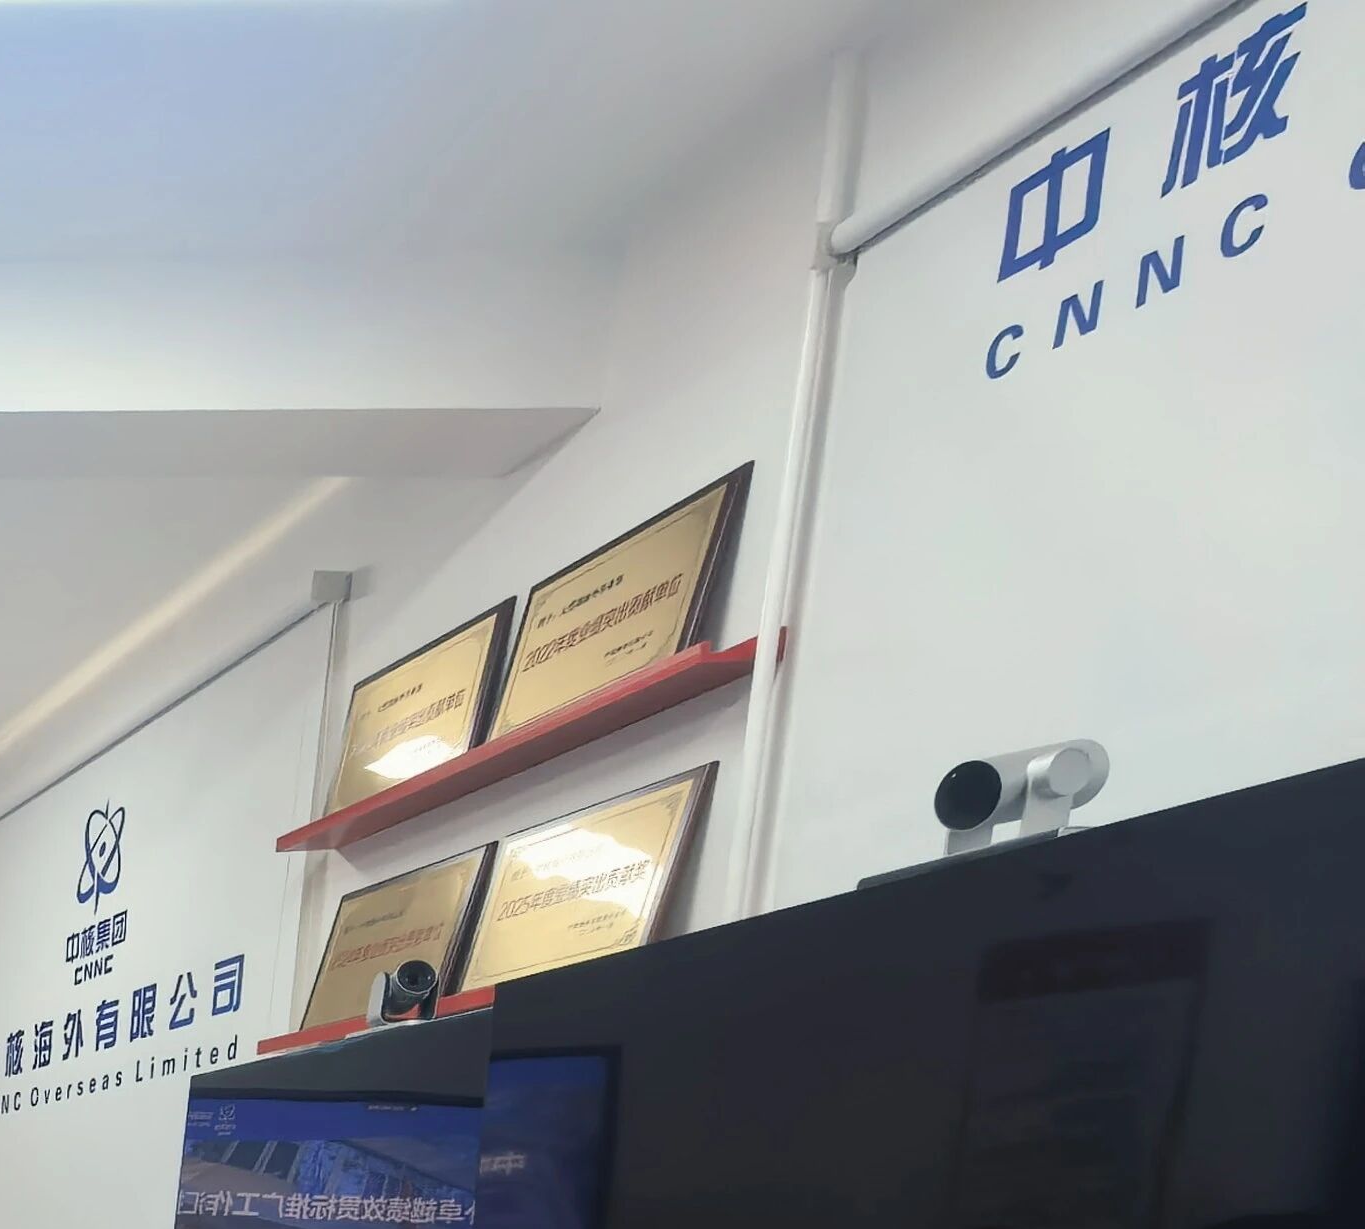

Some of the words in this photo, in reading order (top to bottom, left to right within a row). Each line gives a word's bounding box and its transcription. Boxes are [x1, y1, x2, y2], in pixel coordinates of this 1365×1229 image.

[997, 2, 1308, 283] 中核
[986, 194, 1268, 379] CNNC
[65, 909, 128, 964] 中核集团
[74, 955, 114, 986] CNNC
[30, 1071, 123, 1107] Overseas
[135, 1035, 239, 1083] Limited
